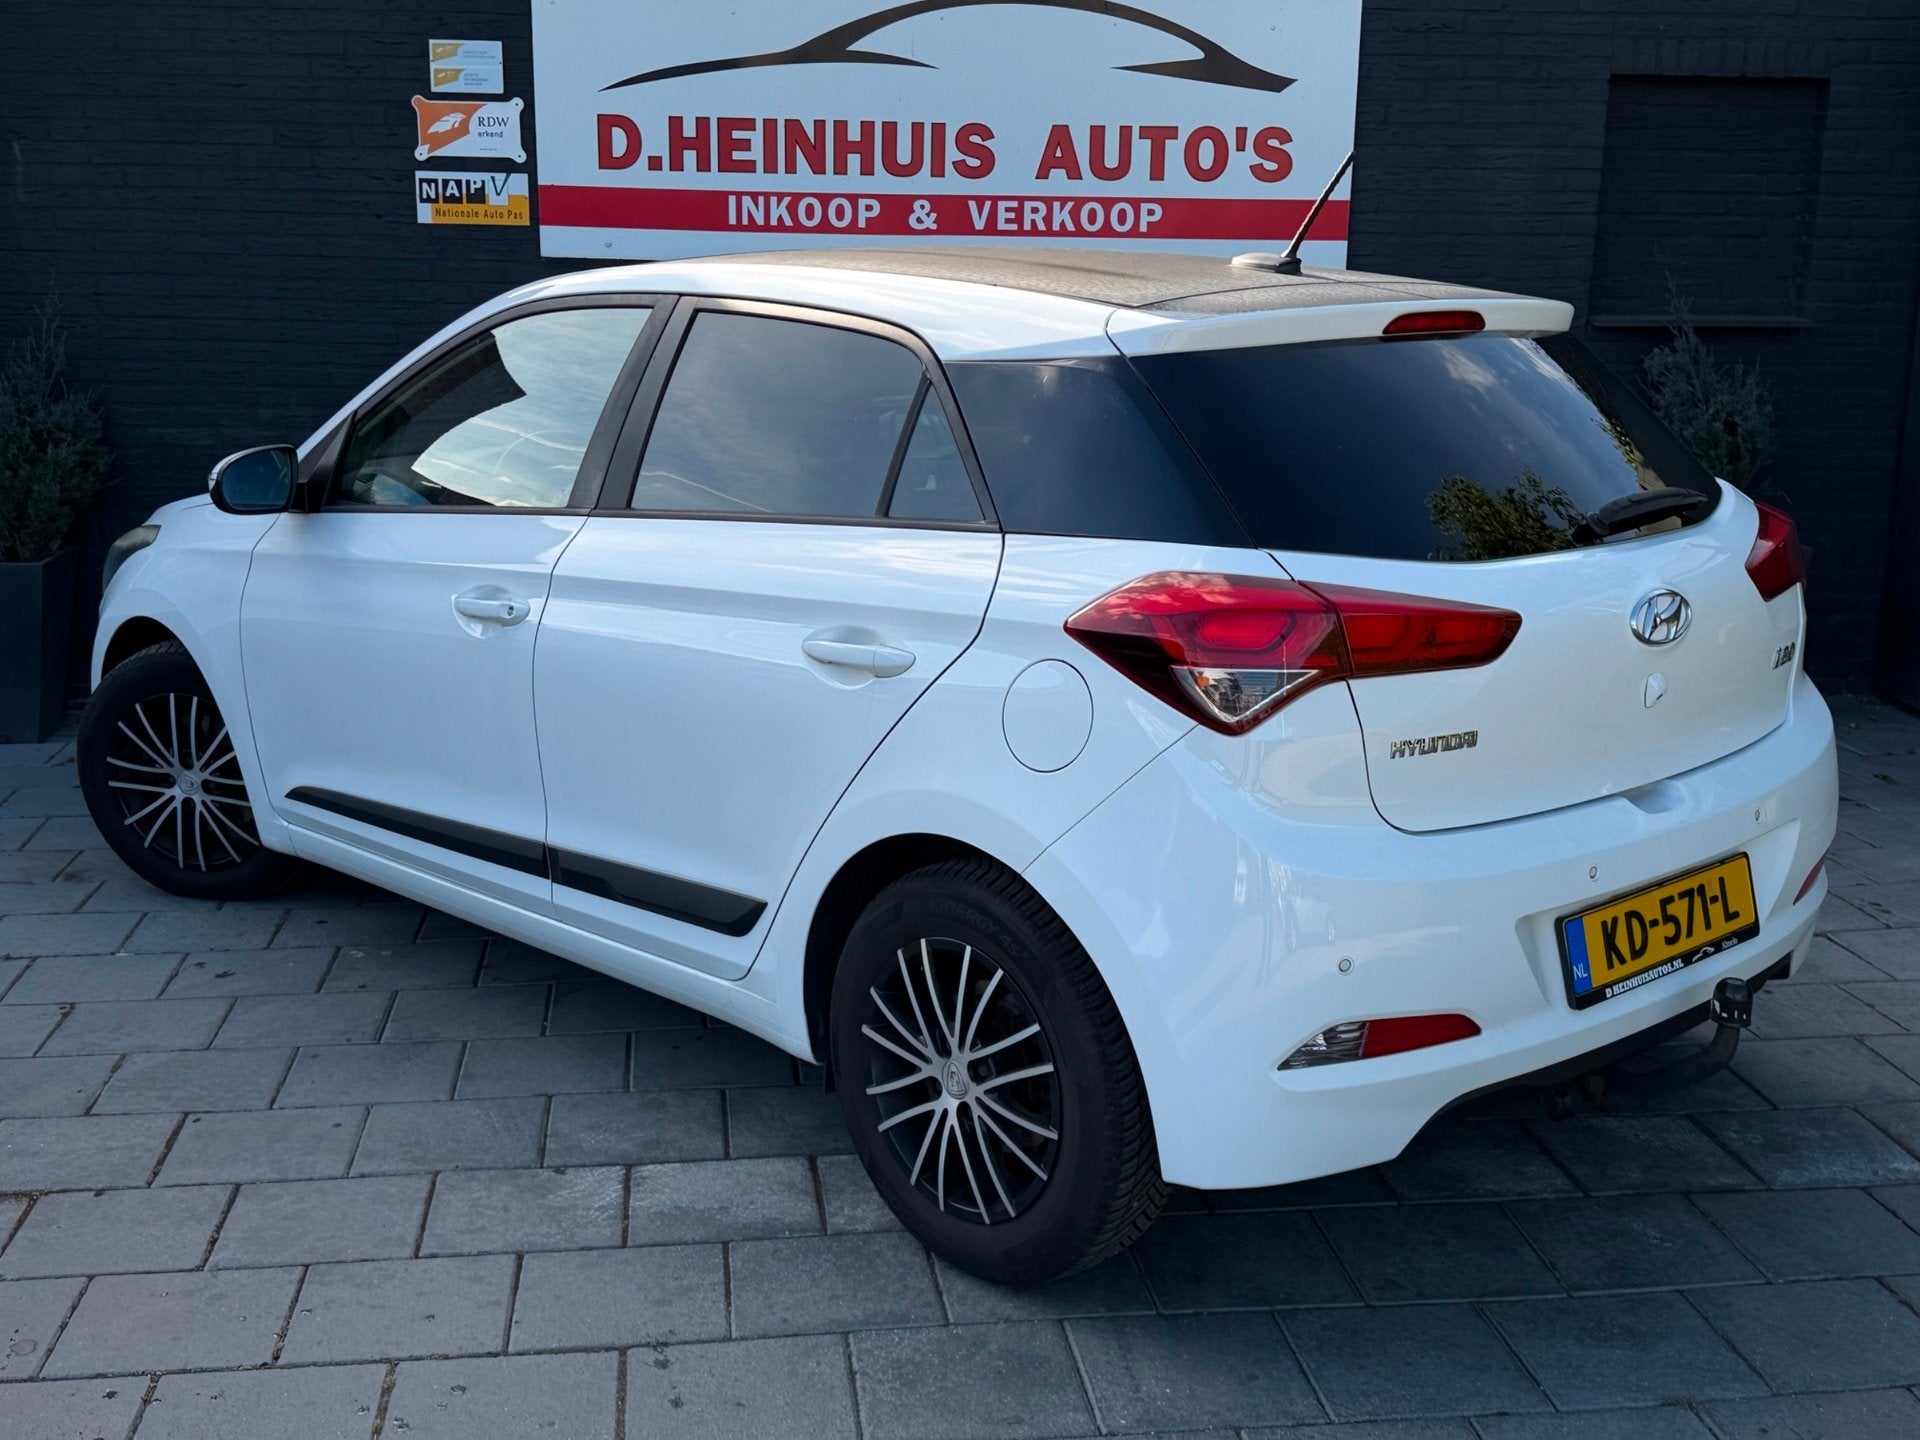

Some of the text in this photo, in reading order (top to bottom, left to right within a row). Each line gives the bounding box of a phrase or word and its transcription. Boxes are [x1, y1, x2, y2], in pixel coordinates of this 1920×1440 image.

[477, 116, 509, 127] RDW
[477, 130, 503, 138] erkend
[597, 113, 1294, 184] D.HEINHUIS AUTO'S
[435, 207, 523, 220] Nationale Auto Pas
[727, 194, 1164, 233] INKOOP & VERKOOP
[1389, 730, 1478, 759] HYUNDAI
[1601, 876, 1740, 970] KD-571-L
[1573, 962, 1588, 980] NL
